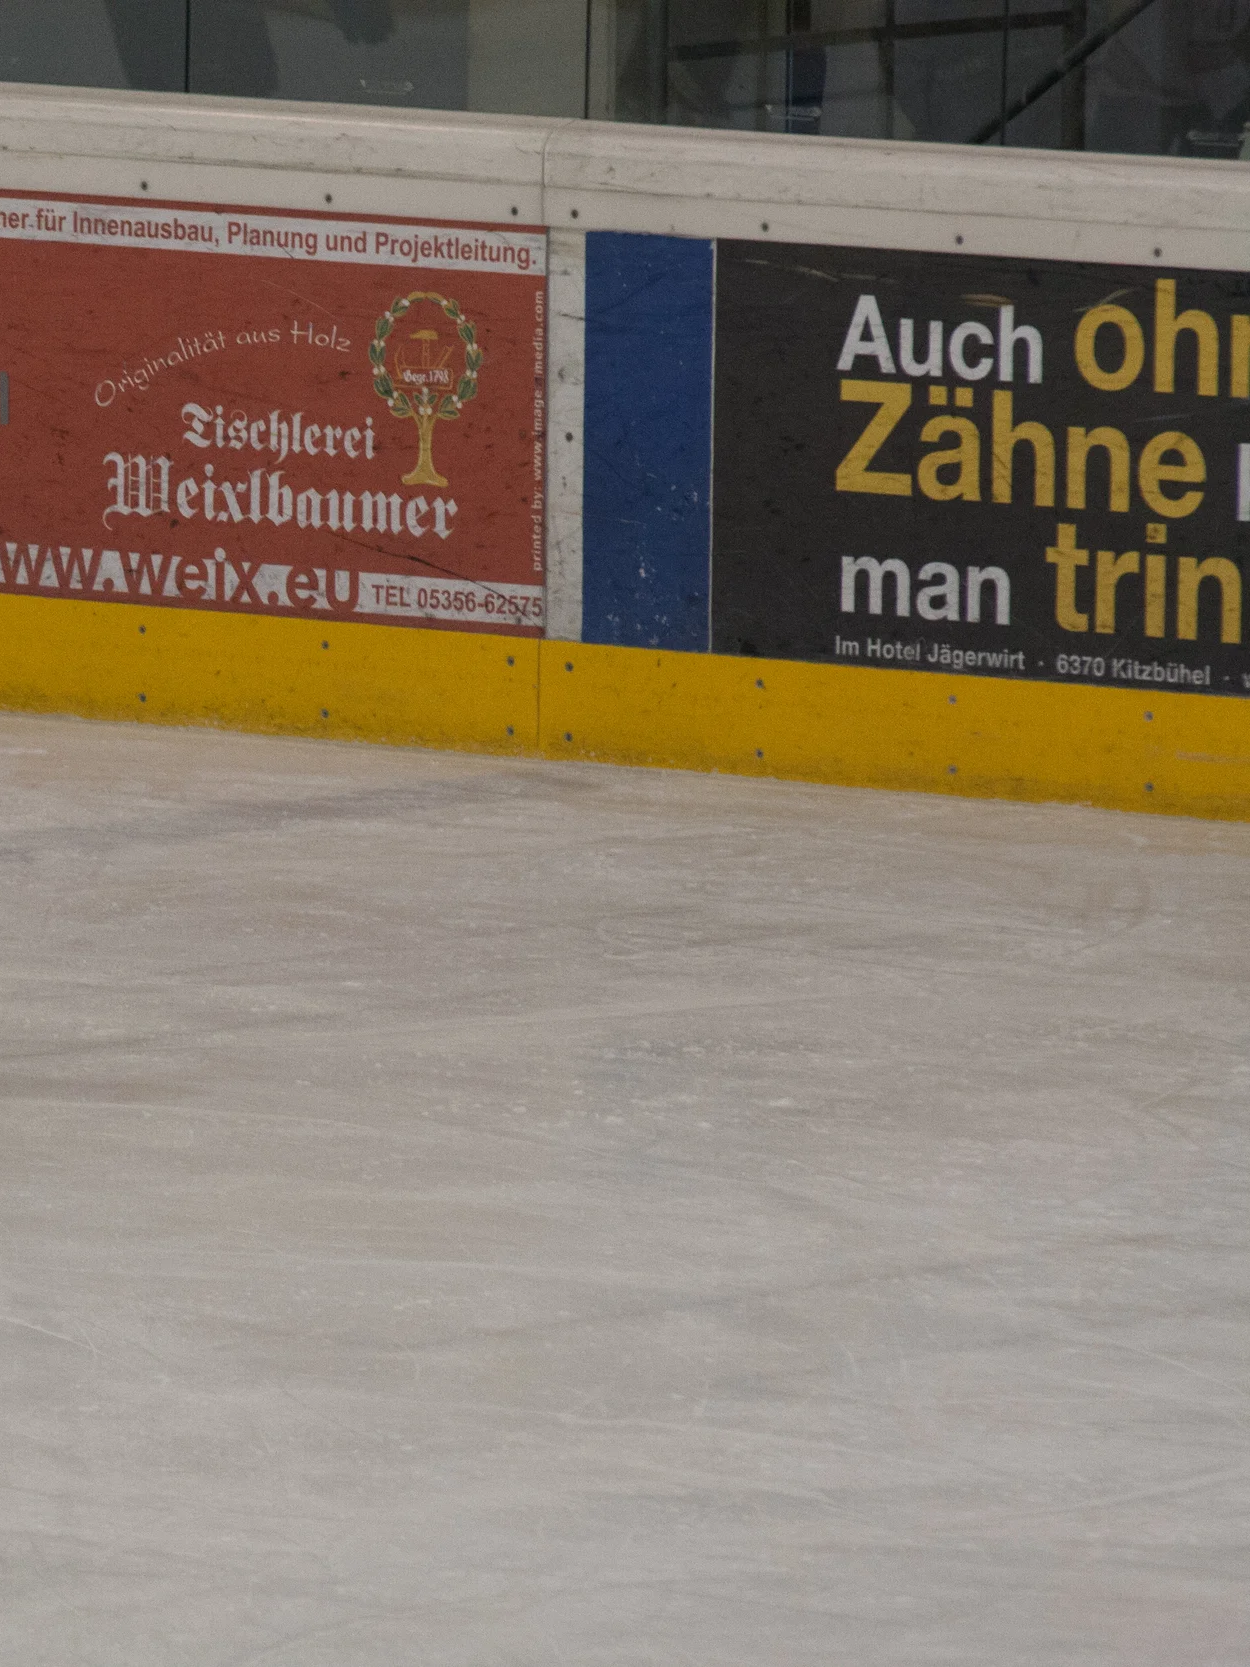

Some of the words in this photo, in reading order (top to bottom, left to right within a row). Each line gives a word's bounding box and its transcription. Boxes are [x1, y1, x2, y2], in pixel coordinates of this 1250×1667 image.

[36, 207, 66, 233] für
[73, 210, 221, 247] Innenausbau,
[228, 221, 318, 255] Planung
[326, 231, 368, 254] und
[376, 232, 537, 270] Projektleitung.
[94, 331, 227, 407] Originalität
[236, 327, 281, 346] aus
[290, 320, 352, 352] Holz
[836, 294, 1044, 384] Auch
[181, 402, 376, 464] Tischlerei
[835, 378, 1207, 519] Zähne
[102, 452, 459, 540] Weixlbaumer
[532, 516, 544, 571] printed
[372, 584, 412, 609] TEL
[417, 587, 543, 617] 05356-62575
[840, 555, 1011, 626] man
[1045, 522, 1243, 644] trin
[835, 634, 860, 656] Im
[866, 638, 921, 662] Hotel
[927, 642, 1027, 671] Jägerwirt
[1056, 653, 1107, 677] 6370
[1111, 657, 1212, 687] Kitzbühel
